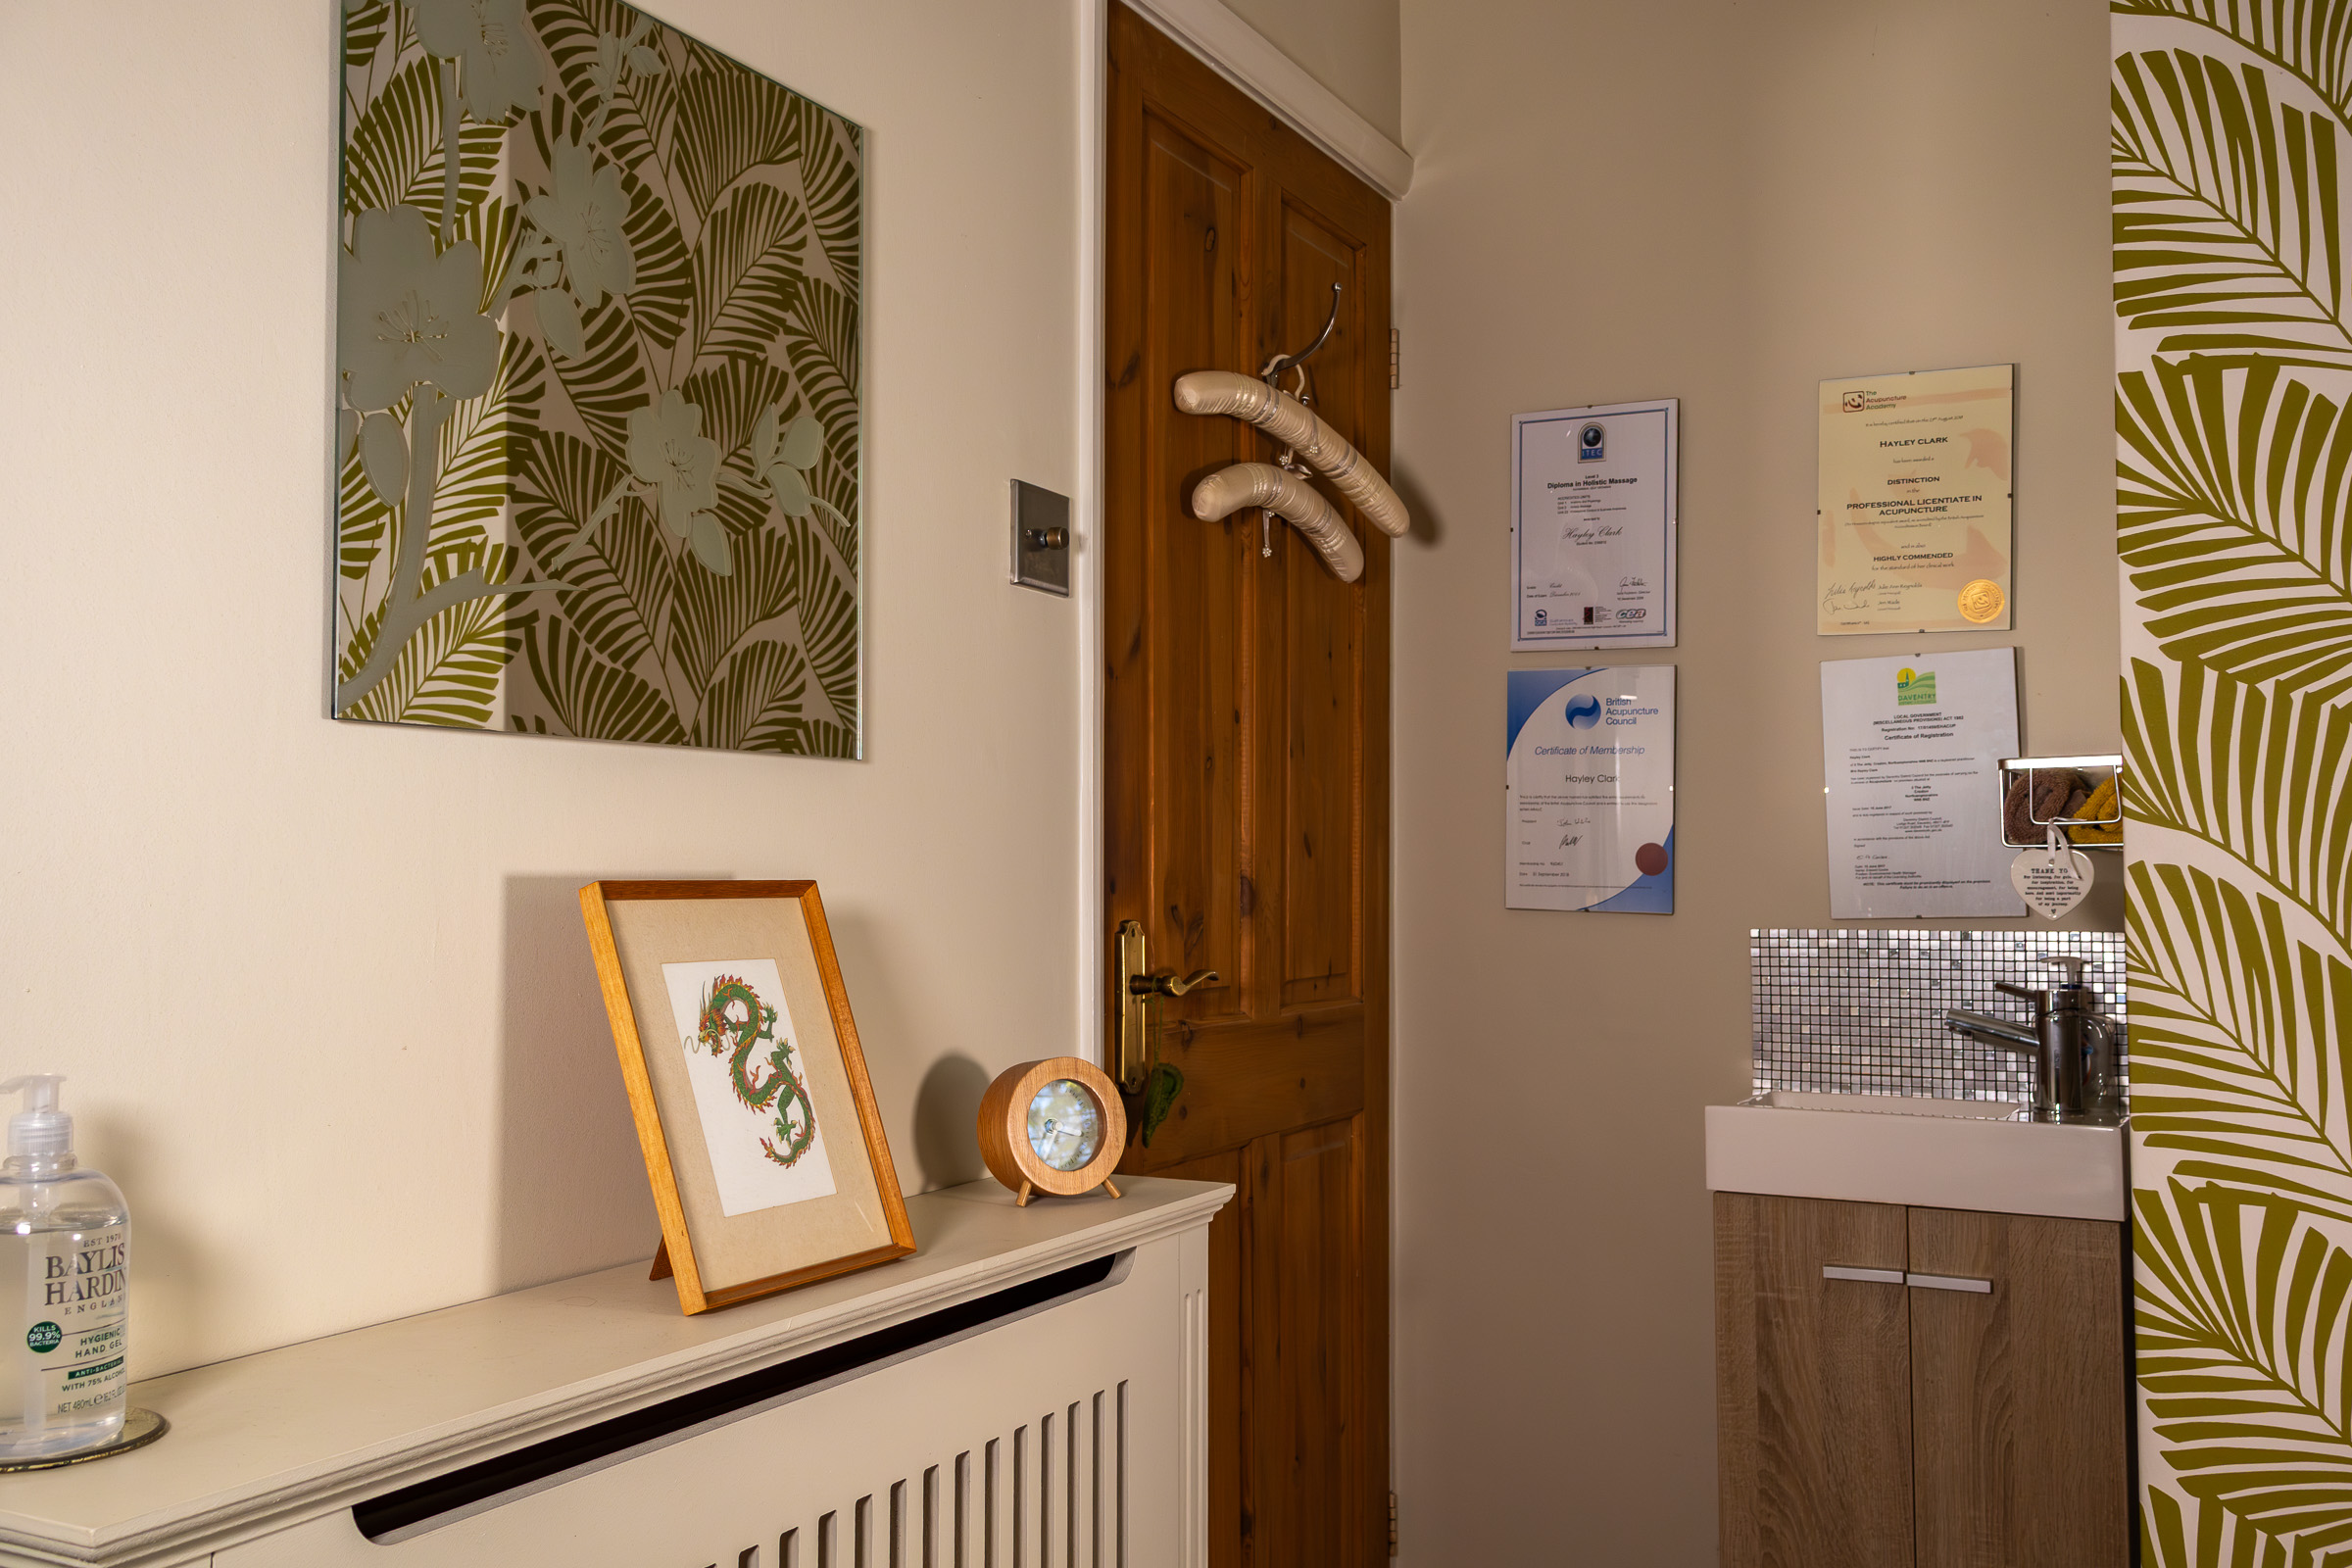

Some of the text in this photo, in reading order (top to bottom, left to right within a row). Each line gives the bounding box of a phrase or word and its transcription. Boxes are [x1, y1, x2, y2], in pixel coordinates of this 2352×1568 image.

[1866, 395, 1907, 404] Acupuncture
[1880, 437, 1948, 448] HAYLEY CLARK
[1547, 481, 1574, 490] Diploma
[1583, 478, 1607, 487] Holistic
[1608, 476, 1638, 485] Massage
[1887, 476, 1940, 485] DISTINCTION
[1846, 500, 1915, 510] PROFESSIONAL
[1917, 496, 1971, 506] LICENTIATE
[1879, 506, 1948, 515] ACUPUNCTURE
[1562, 525, 1624, 542] Hayley Clark
[1902, 552, 1954, 561] COMMENDED
[1616, 609, 1646, 619] cea
[1605, 697, 1632, 706] British
[1898, 693, 1936, 702] DAVENTRY
[1605, 707, 1659, 717] Acupuncture
[1605, 716, 1637, 725] Council
[1535, 745, 1645, 757] Certificate of Membership
[1565, 774, 1595, 784] Hayley
[83, 1238, 103, 1248] EST
[45, 1242, 125, 1280] BAYLIS
[44, 1268, 126, 1306] HARDIN
[64, 1294, 123, 1316] ENGLAN
[33, 1324, 57, 1333] KILLS
[28, 1330, 61, 1343] 99.9%
[80, 1327, 122, 1347] HYGIENIC
[29, 1339, 60, 1348] BACTERIA
[74, 1338, 122, 1358] HAND GEL
[62, 1367, 125, 1393] WITH 75% ALCOHO
[58, 1401, 72, 1414] NET
